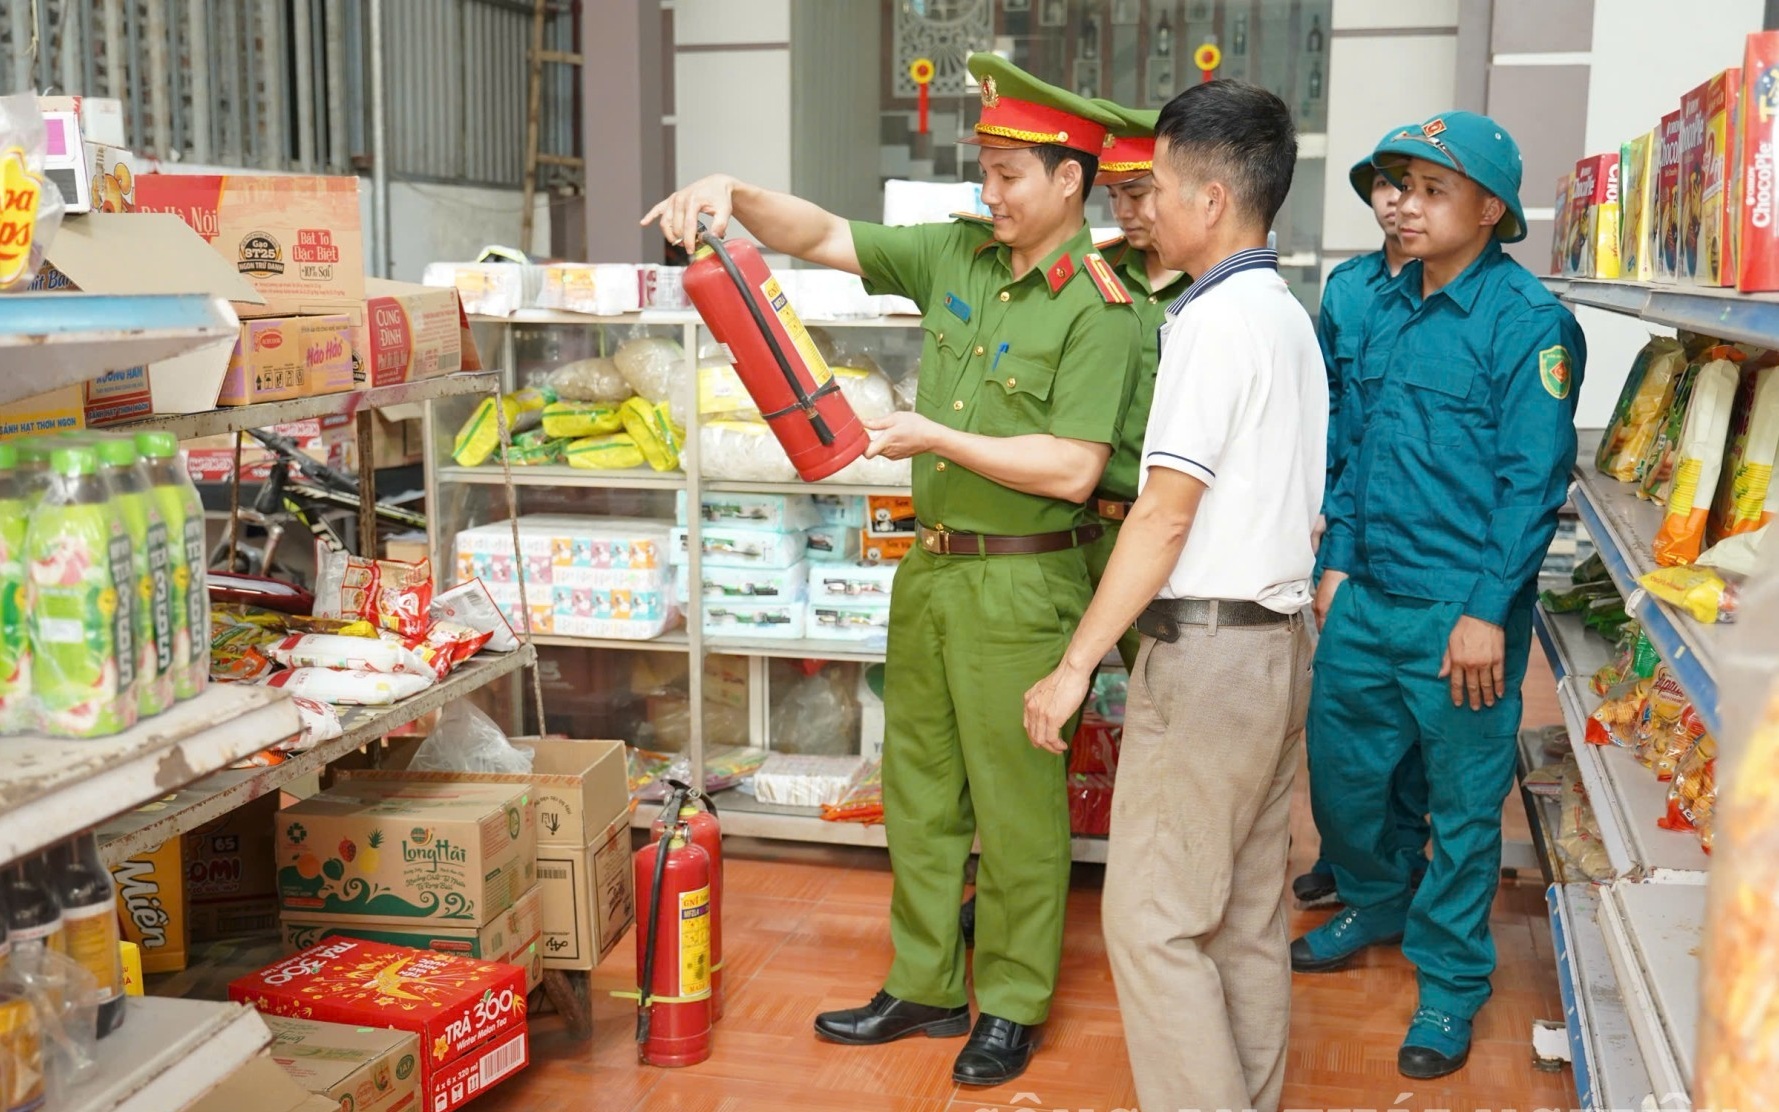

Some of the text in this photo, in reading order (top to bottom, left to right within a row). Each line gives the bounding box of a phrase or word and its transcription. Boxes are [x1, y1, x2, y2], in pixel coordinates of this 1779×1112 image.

[252, 240, 268, 249] Gạo
[300, 232, 329, 245] Bát To
[245, 248, 276, 259] ST25
[376, 309, 400, 327] CUNG
[58, 417, 76, 428] NGON
[214, 837, 236, 850] 65
[445, 988, 513, 1045] TRÀ 360
[457, 1017, 507, 1051] Winter Melon Tea
[435, 1084, 440, 1092] 4
[447, 1078, 451, 1086] 6
